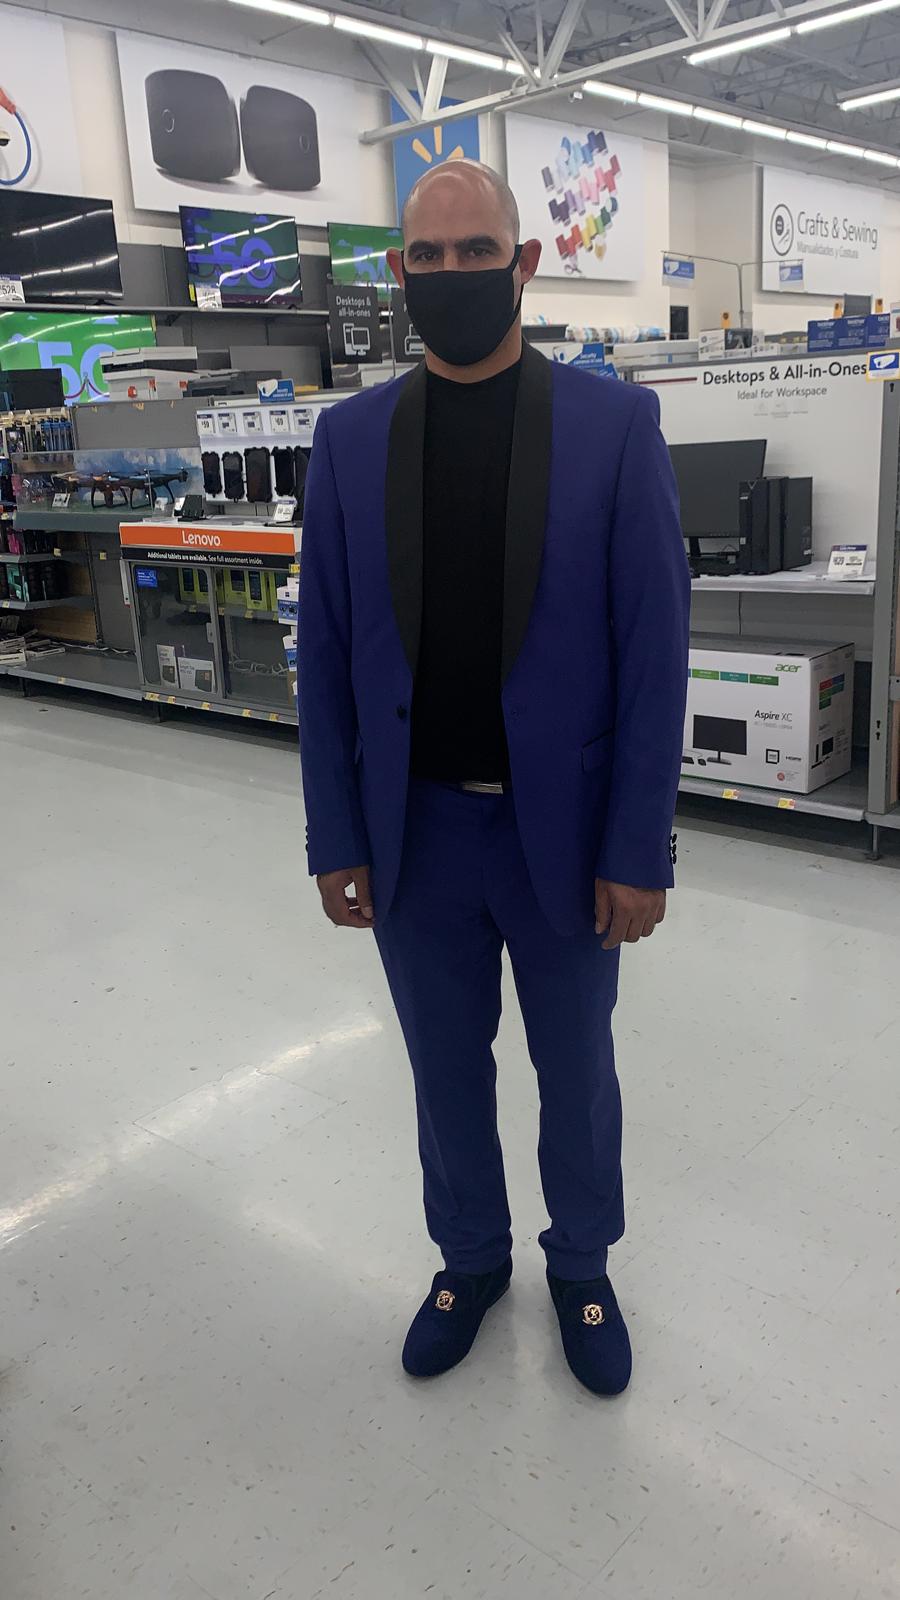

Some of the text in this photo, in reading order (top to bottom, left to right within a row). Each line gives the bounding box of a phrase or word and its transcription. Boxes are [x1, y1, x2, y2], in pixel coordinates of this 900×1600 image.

[797, 210, 878, 250] Crafts & Sewing
[335, 295, 371, 308] Desktops &
[338, 307, 371, 317] all-in-ones
[702, 370, 765, 386] Desktops
[769, 365, 780, 380] &
[783, 361, 867, 379] All-in-Ones
[737, 386, 828, 401] Ideal for Workspace
[182, 530, 221, 546] Lenovo
[147, 551, 168, 559] Additional
[189, 554, 208, 562] available.
[224, 556, 249, 564] assortment
[249, 557, 264, 565] inside.
[774, 663, 802, 673] acer
[754, 709, 793, 723] Aspire XC
